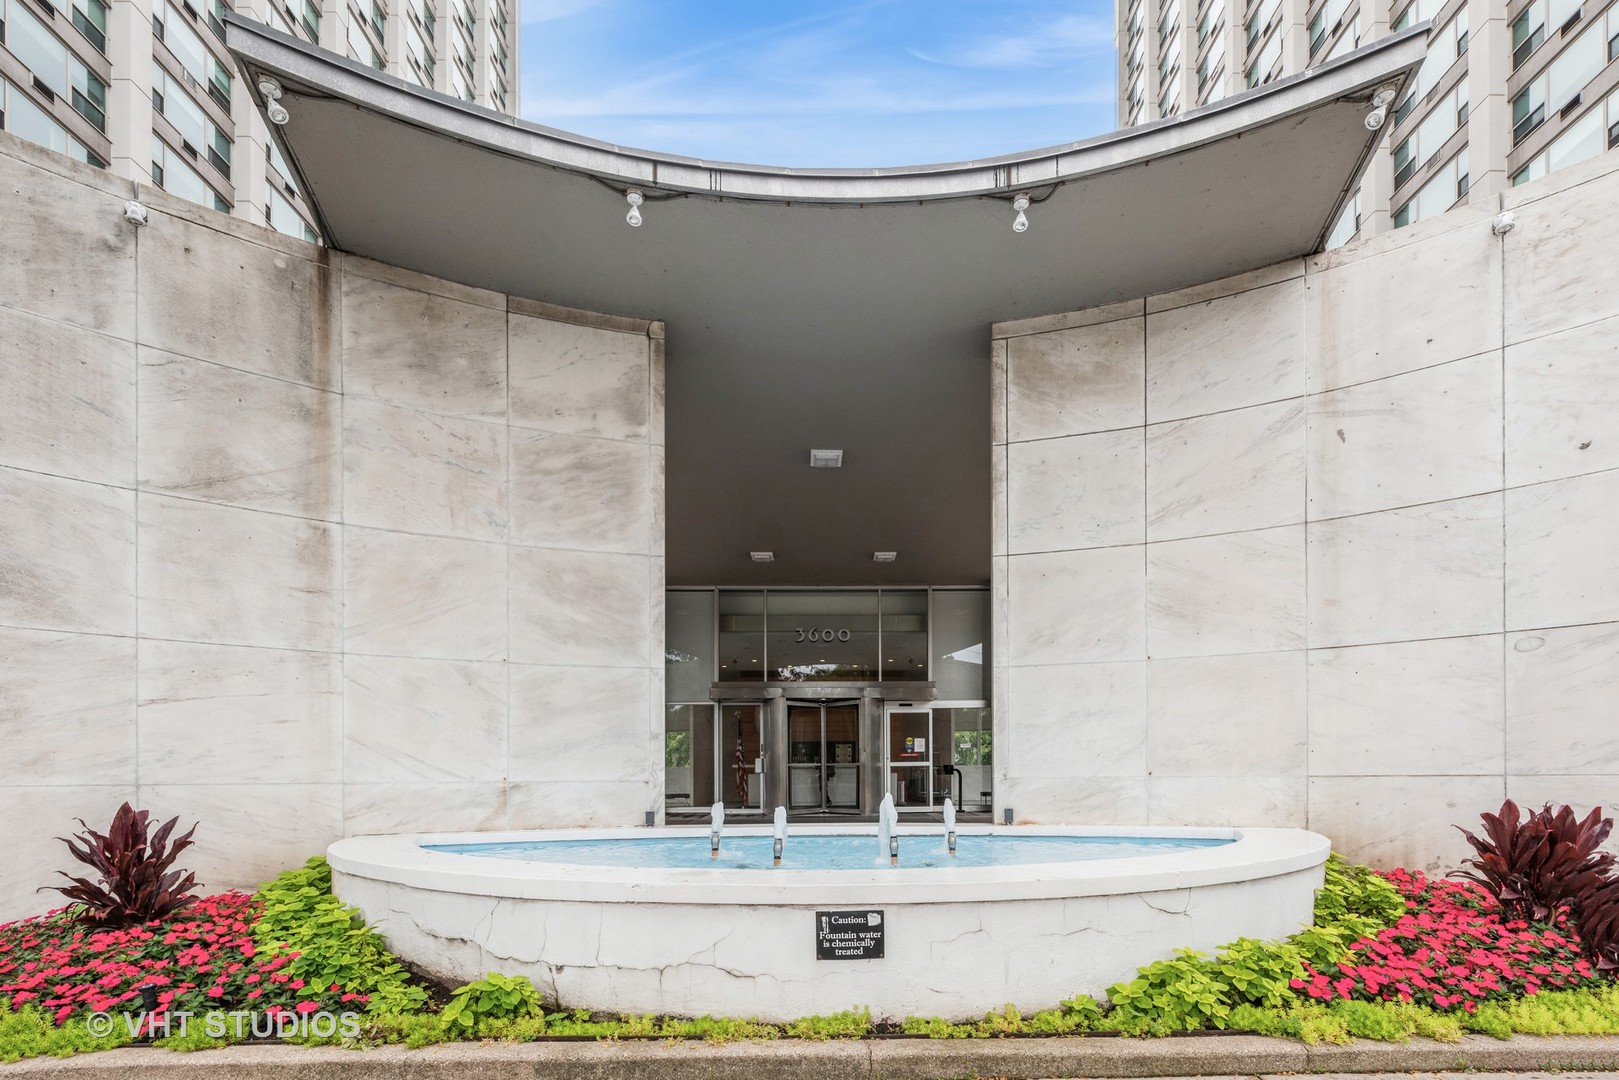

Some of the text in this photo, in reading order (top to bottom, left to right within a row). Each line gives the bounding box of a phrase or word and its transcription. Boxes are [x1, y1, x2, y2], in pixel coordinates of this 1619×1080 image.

[795, 627, 850, 642] 3600
[831, 915, 867, 924] Caution:
[819, 931, 857, 939] Fountain
[823, 939, 876, 949] is chemically
[835, 947, 864, 956] treated
